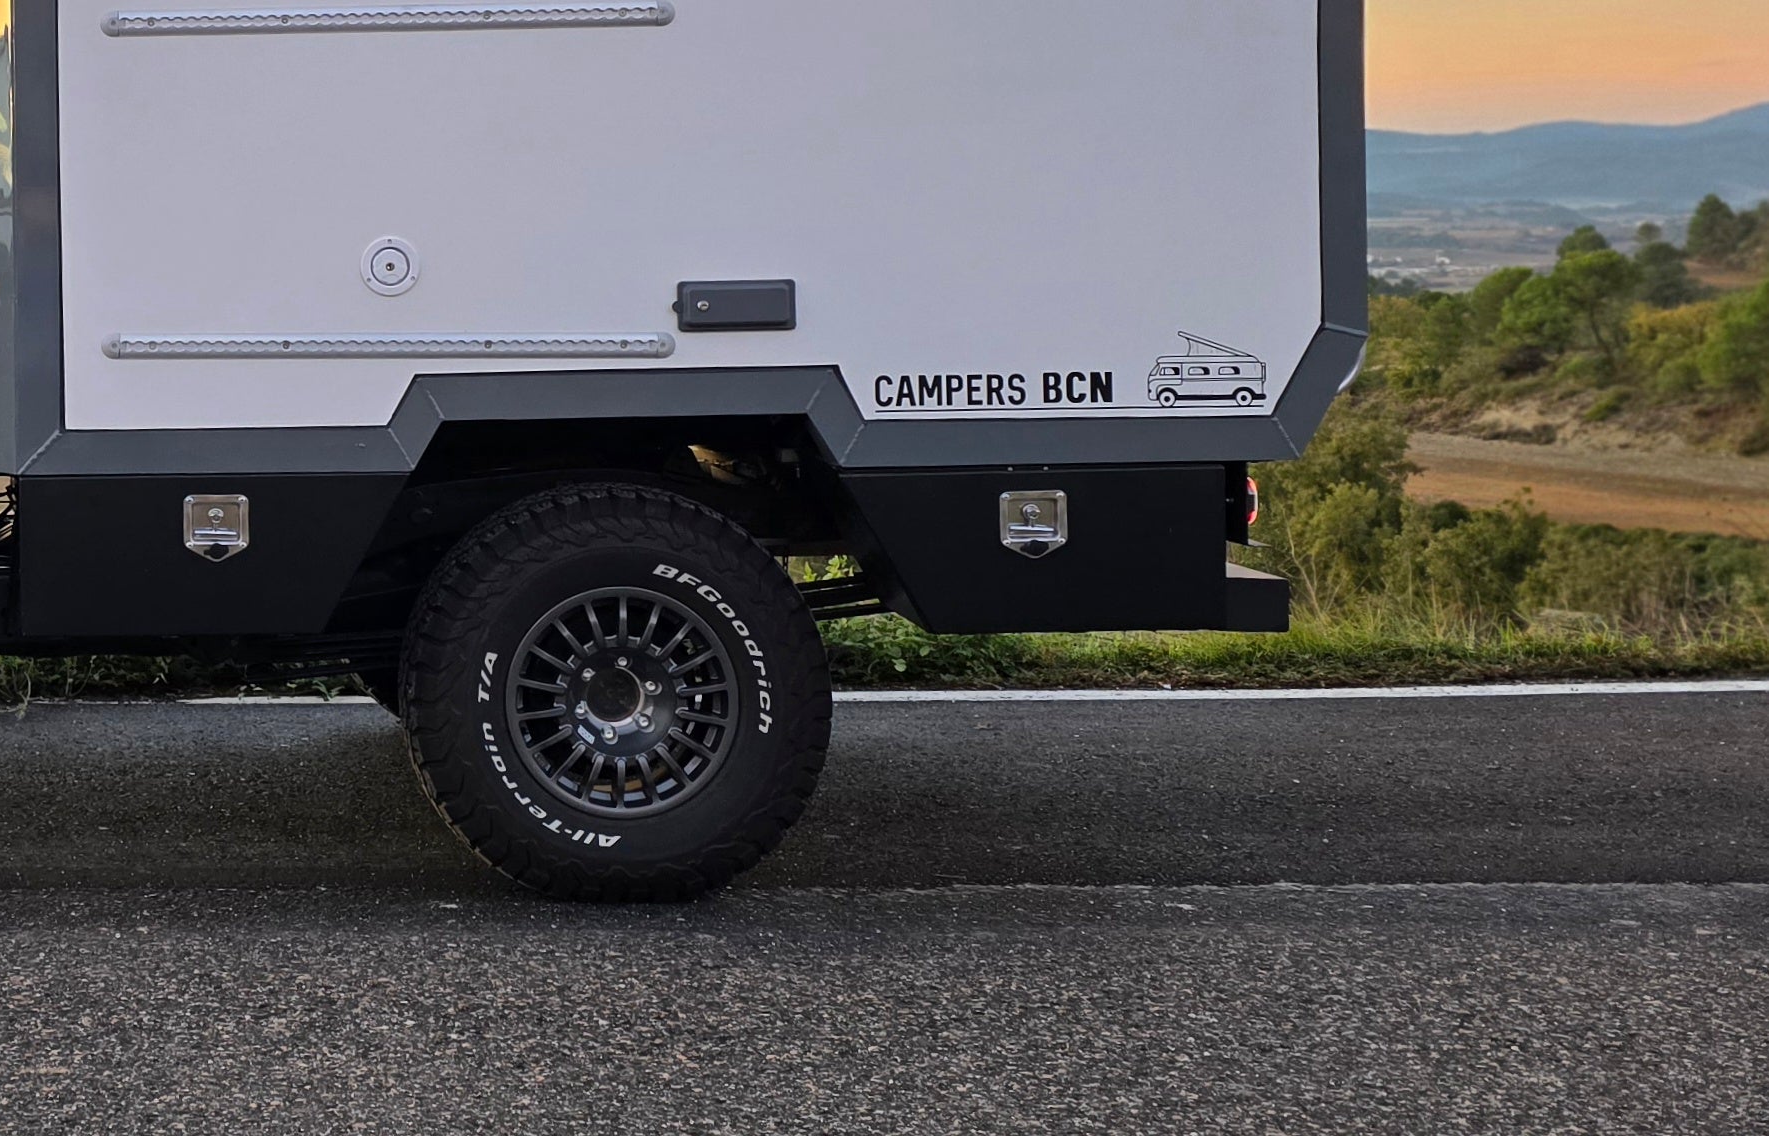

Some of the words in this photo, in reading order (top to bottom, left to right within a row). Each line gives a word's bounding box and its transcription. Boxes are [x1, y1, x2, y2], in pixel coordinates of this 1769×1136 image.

[874, 373, 1026, 407] CAMPERS
[1042, 371, 1113, 404] BCN
[477, 651, 498, 704] T/A
[652, 563, 773, 734] BFGoodrich
[477, 722, 622, 848] All-Terrain
